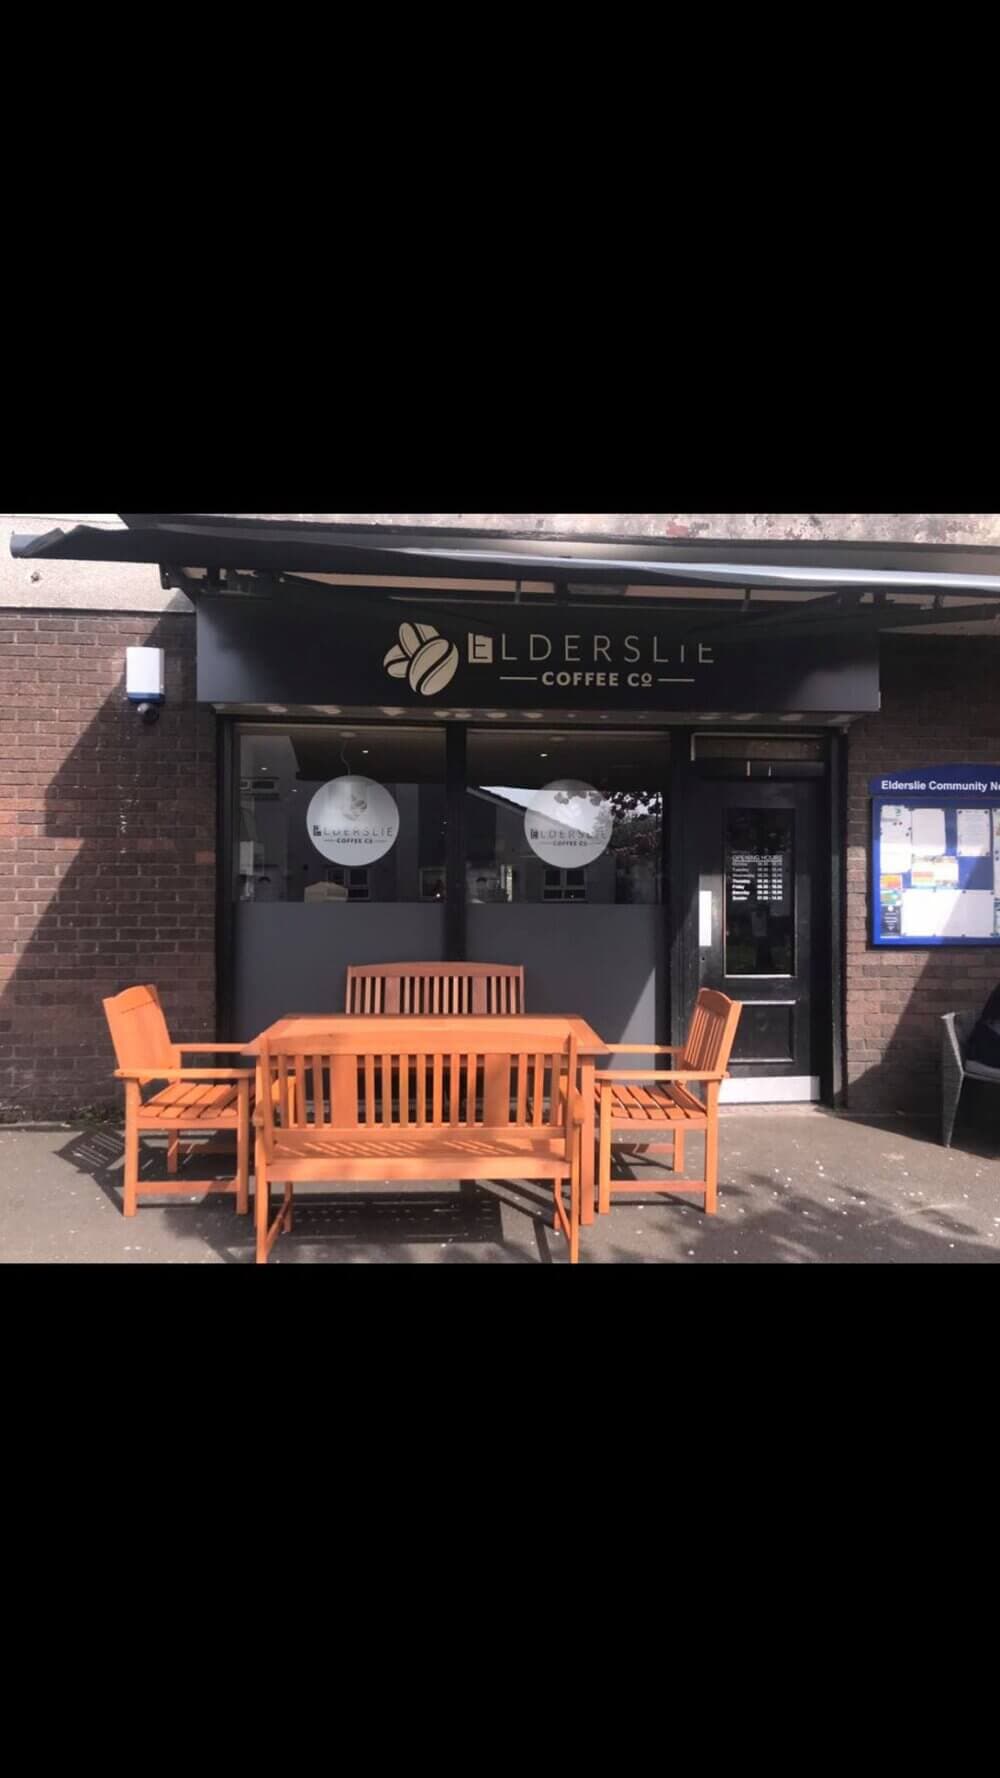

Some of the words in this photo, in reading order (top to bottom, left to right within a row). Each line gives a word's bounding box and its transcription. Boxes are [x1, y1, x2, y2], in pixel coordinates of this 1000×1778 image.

[468, 632, 714, 663] ELDERSLIE
[542, 671, 619, 687] COFFEE
[881, 780, 926, 790] Elderslie
[928, 780, 987, 793] Community
